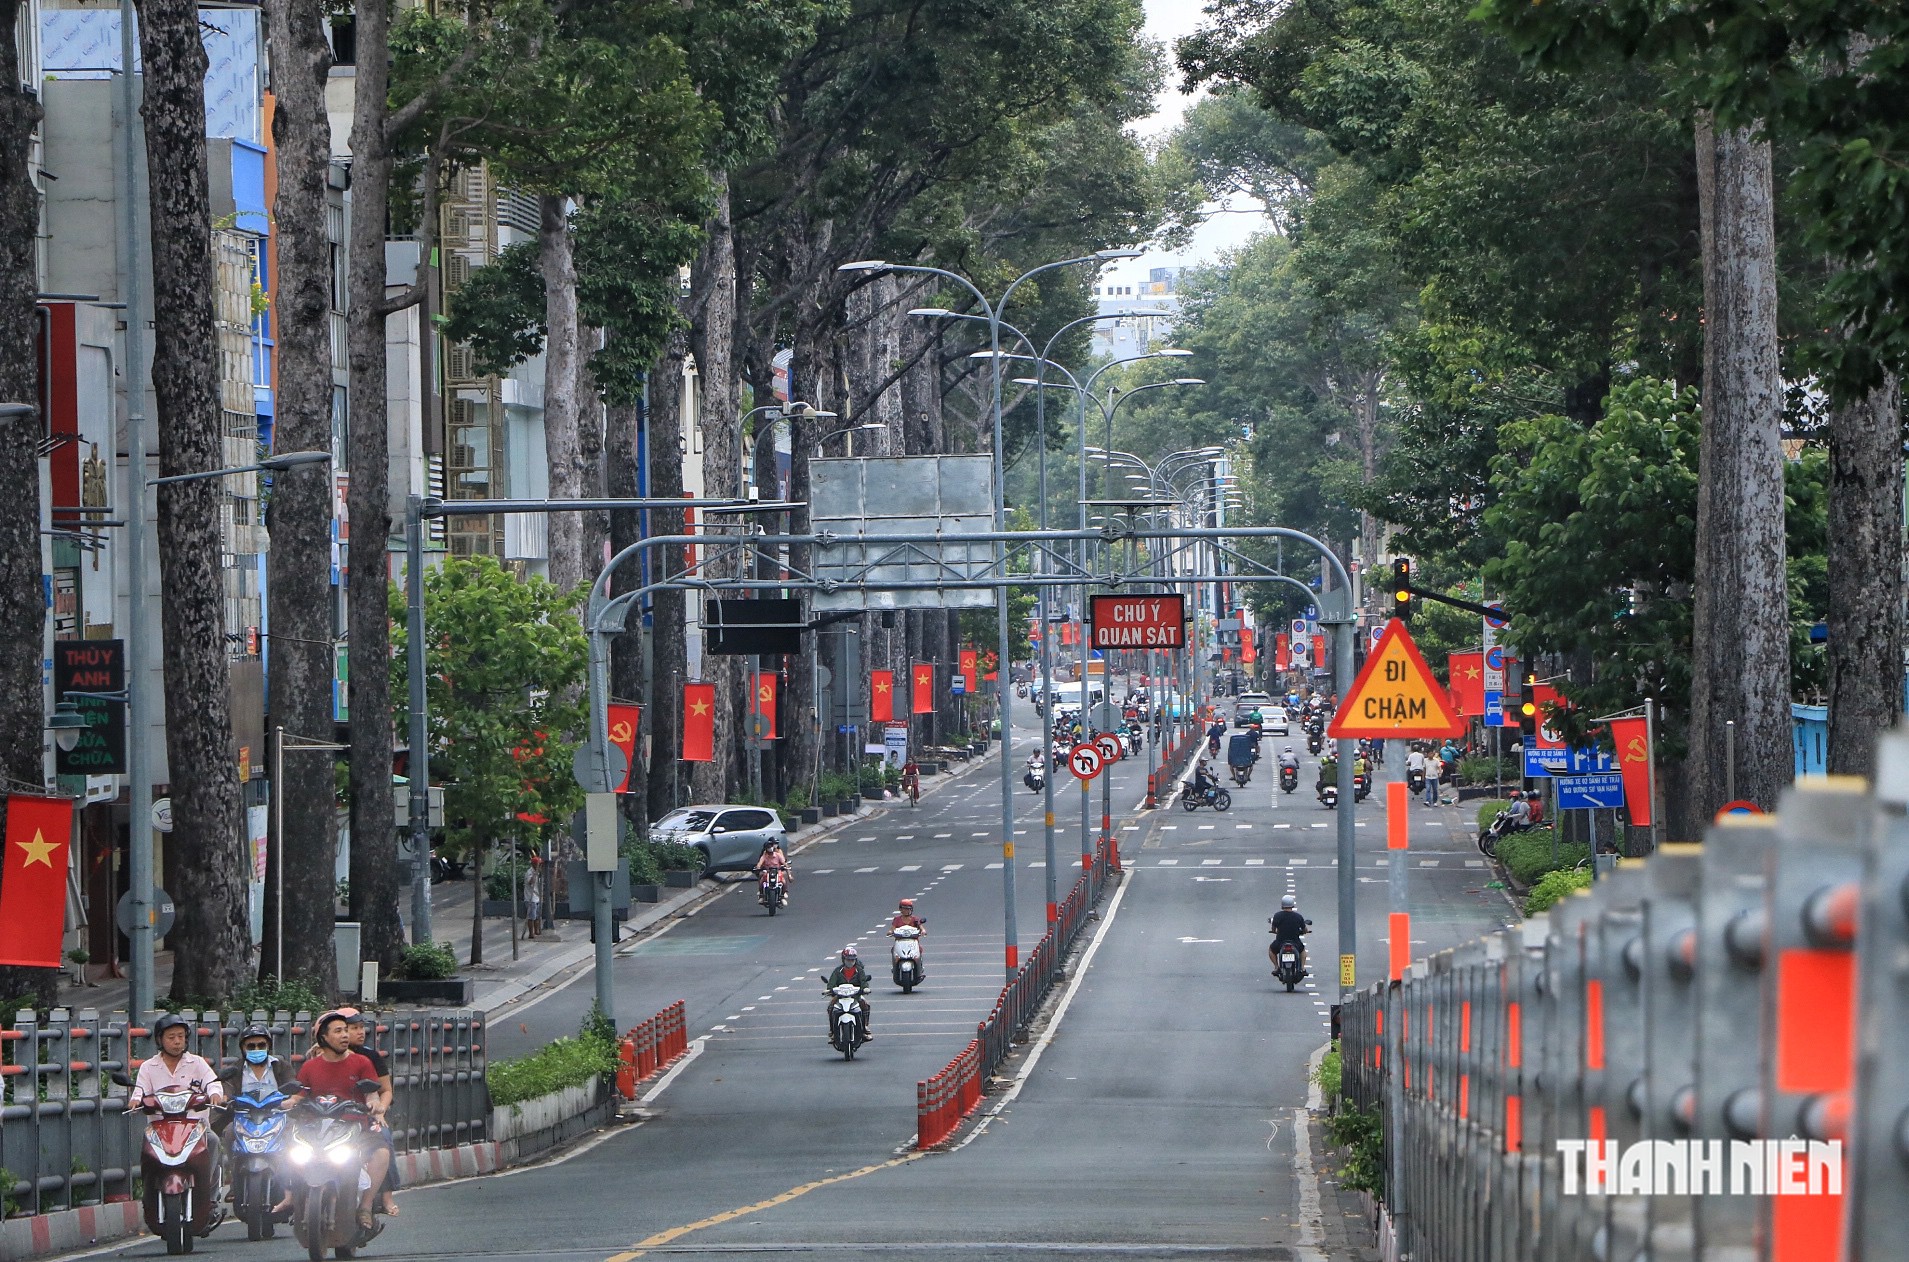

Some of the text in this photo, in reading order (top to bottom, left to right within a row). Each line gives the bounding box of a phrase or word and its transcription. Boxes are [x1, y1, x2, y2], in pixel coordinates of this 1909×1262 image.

[1113, 598, 1161, 622] CHÚ Ý
[1098, 622, 1177, 646] QUAN SÁT
[65, 647, 113, 666] THÙY
[70, 671, 111, 687] ANH
[1384, 660, 1406, 682] ĐI
[1364, 693, 1426, 723] CHẬM
[67, 751, 114, 766] CHỮA
